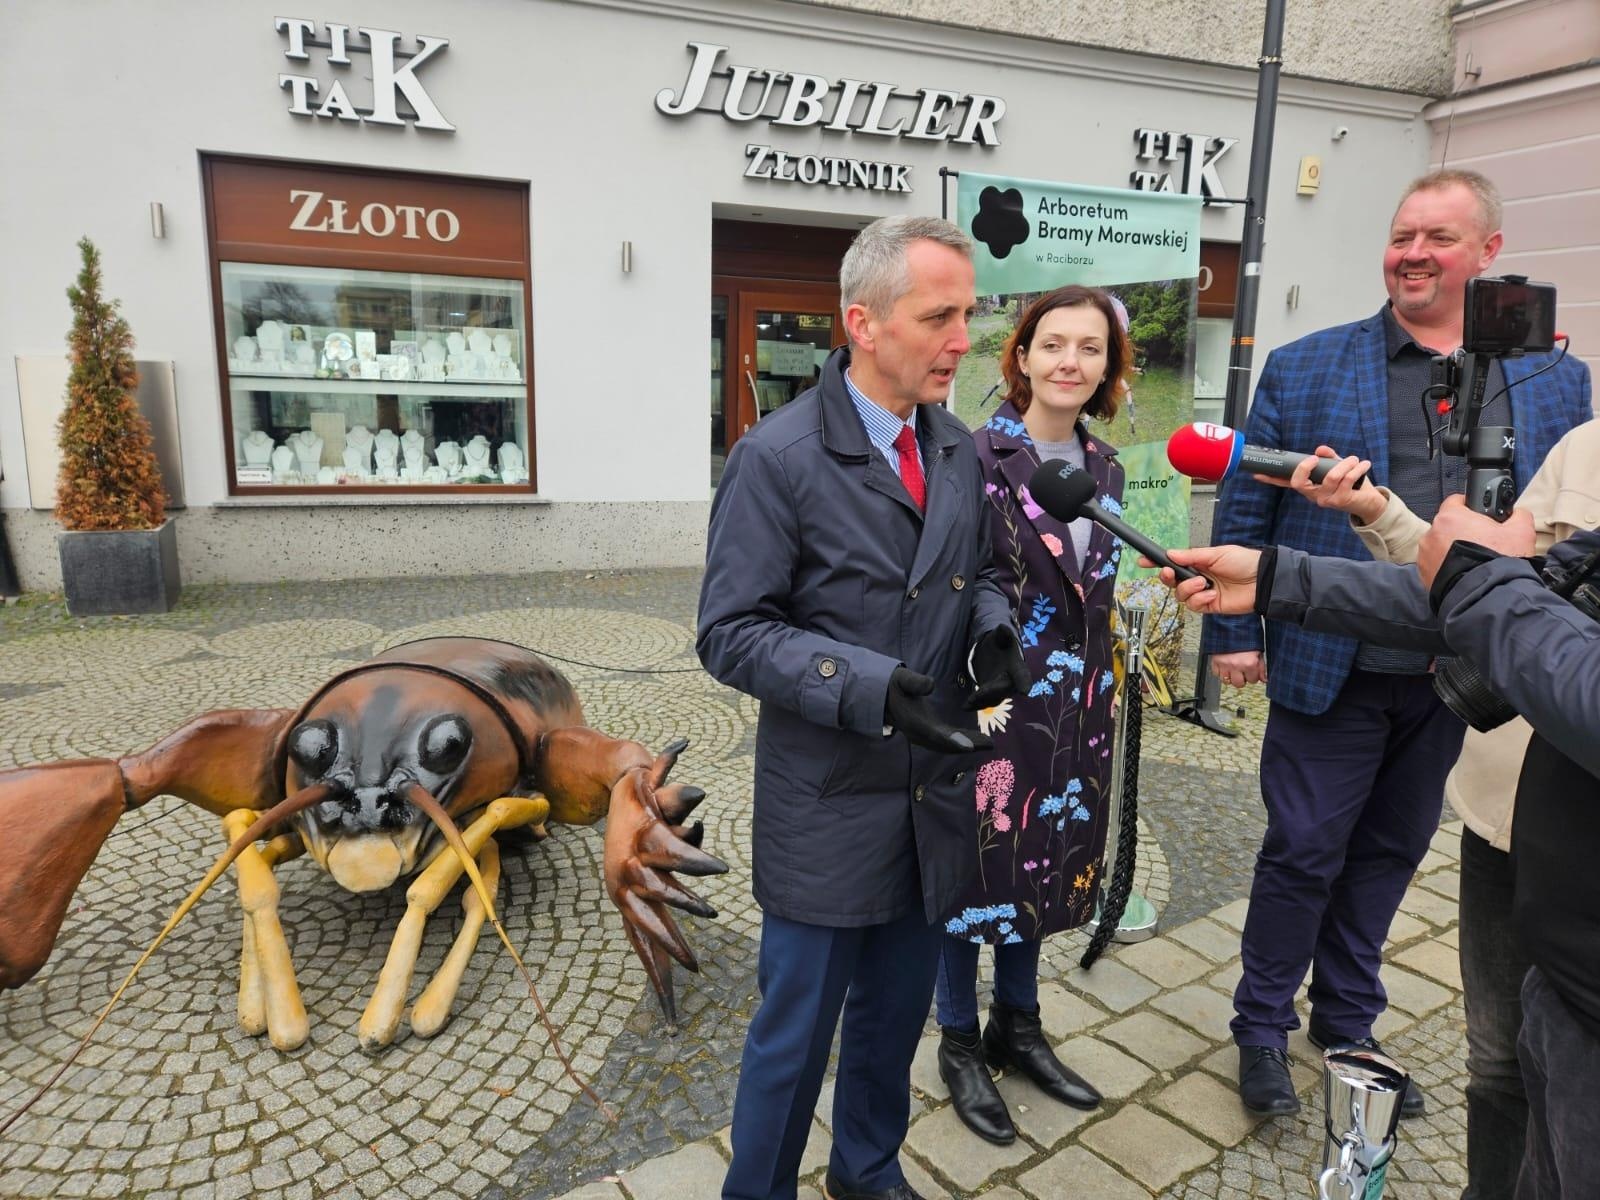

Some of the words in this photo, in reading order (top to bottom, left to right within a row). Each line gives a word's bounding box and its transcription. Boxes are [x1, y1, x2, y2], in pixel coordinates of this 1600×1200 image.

[655, 41, 1007, 147] JUBILER
[744, 143, 914, 193] ZŁOTNIK
[289, 189, 460, 242] ZŁOTO
[1037, 196, 1129, 220] Arboretum
[1038, 220, 1094, 247] Bramy
[1097, 225, 1189, 253] Morawskiej
[1035, 254, 1044, 262] w
[1046, 252, 1094, 265] Raciborzu
